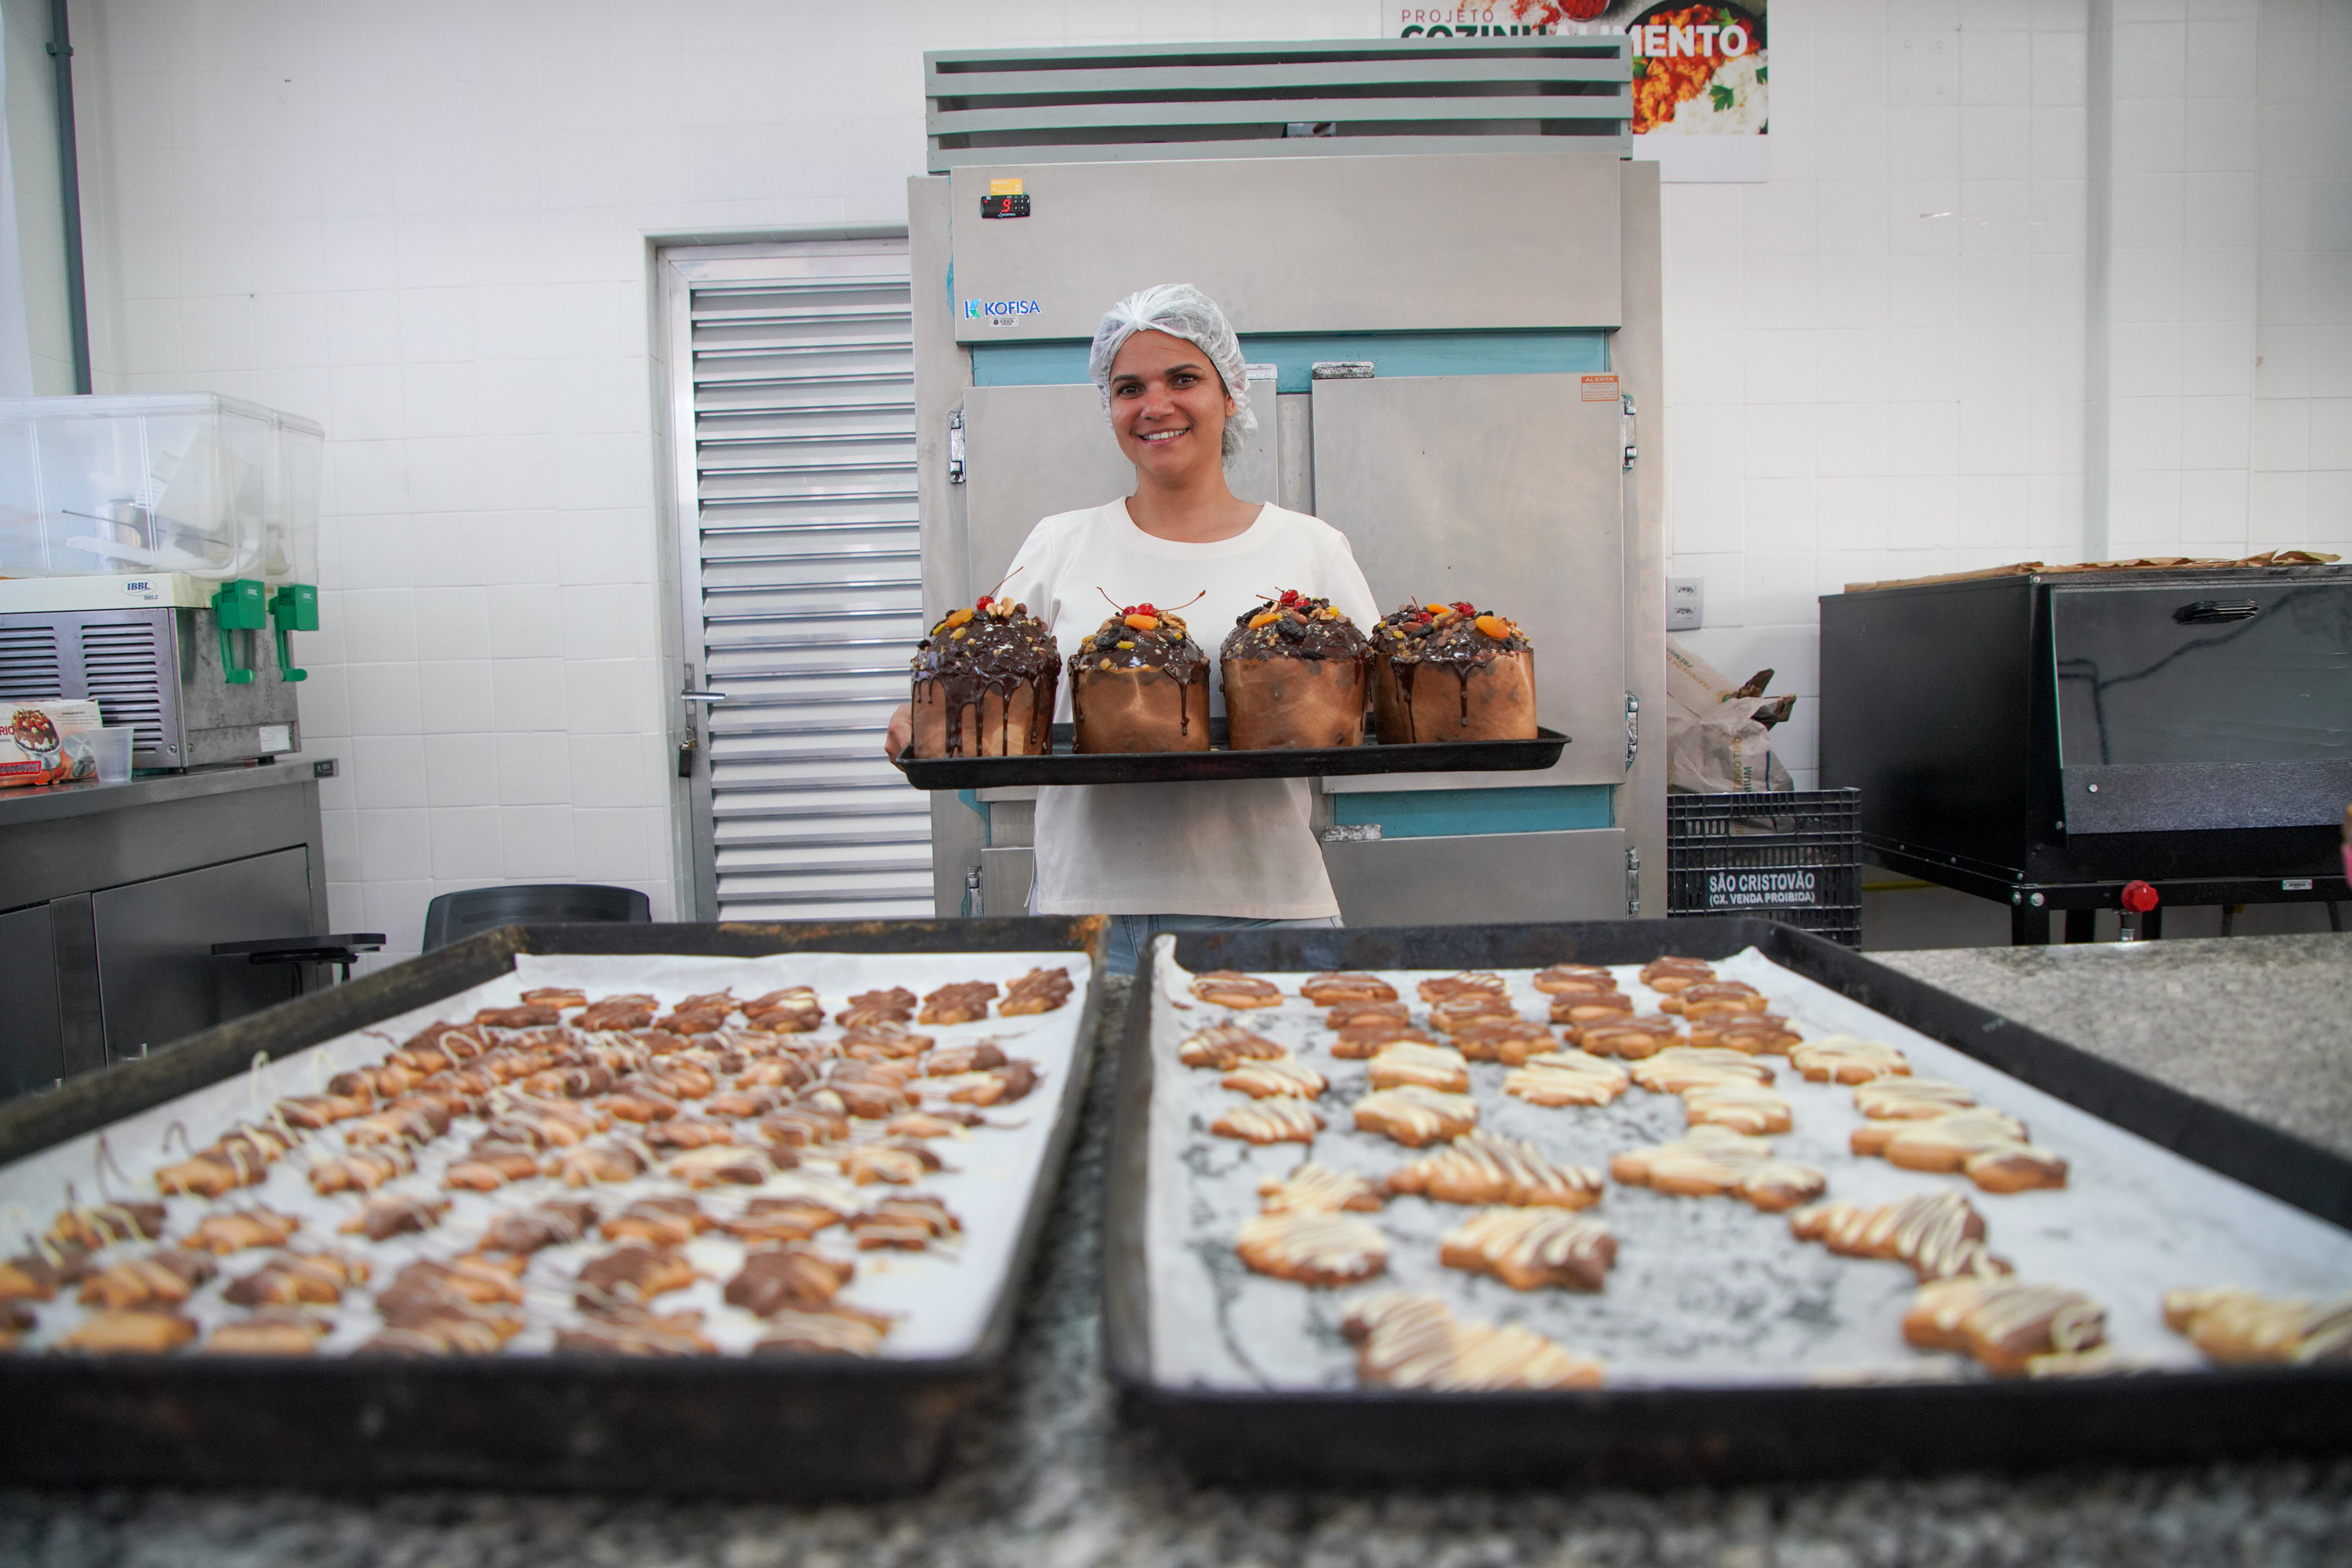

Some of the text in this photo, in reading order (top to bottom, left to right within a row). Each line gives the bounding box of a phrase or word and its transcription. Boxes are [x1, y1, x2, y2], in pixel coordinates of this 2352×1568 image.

[1401, 9, 1494, 23] PROJETO
[985, 300, 1040, 316] KOFISA
[127, 582, 150, 590] IBBL
[1733, 736, 1743, 760] TIPO
[1733, 760, 1743, 792] TRIGO
[1709, 870, 1816, 892] SÃO CRISTOVÃO
[1730, 893, 1764, 905] VENDA
[1764, 891, 1816, 904] PROIBIDA)
